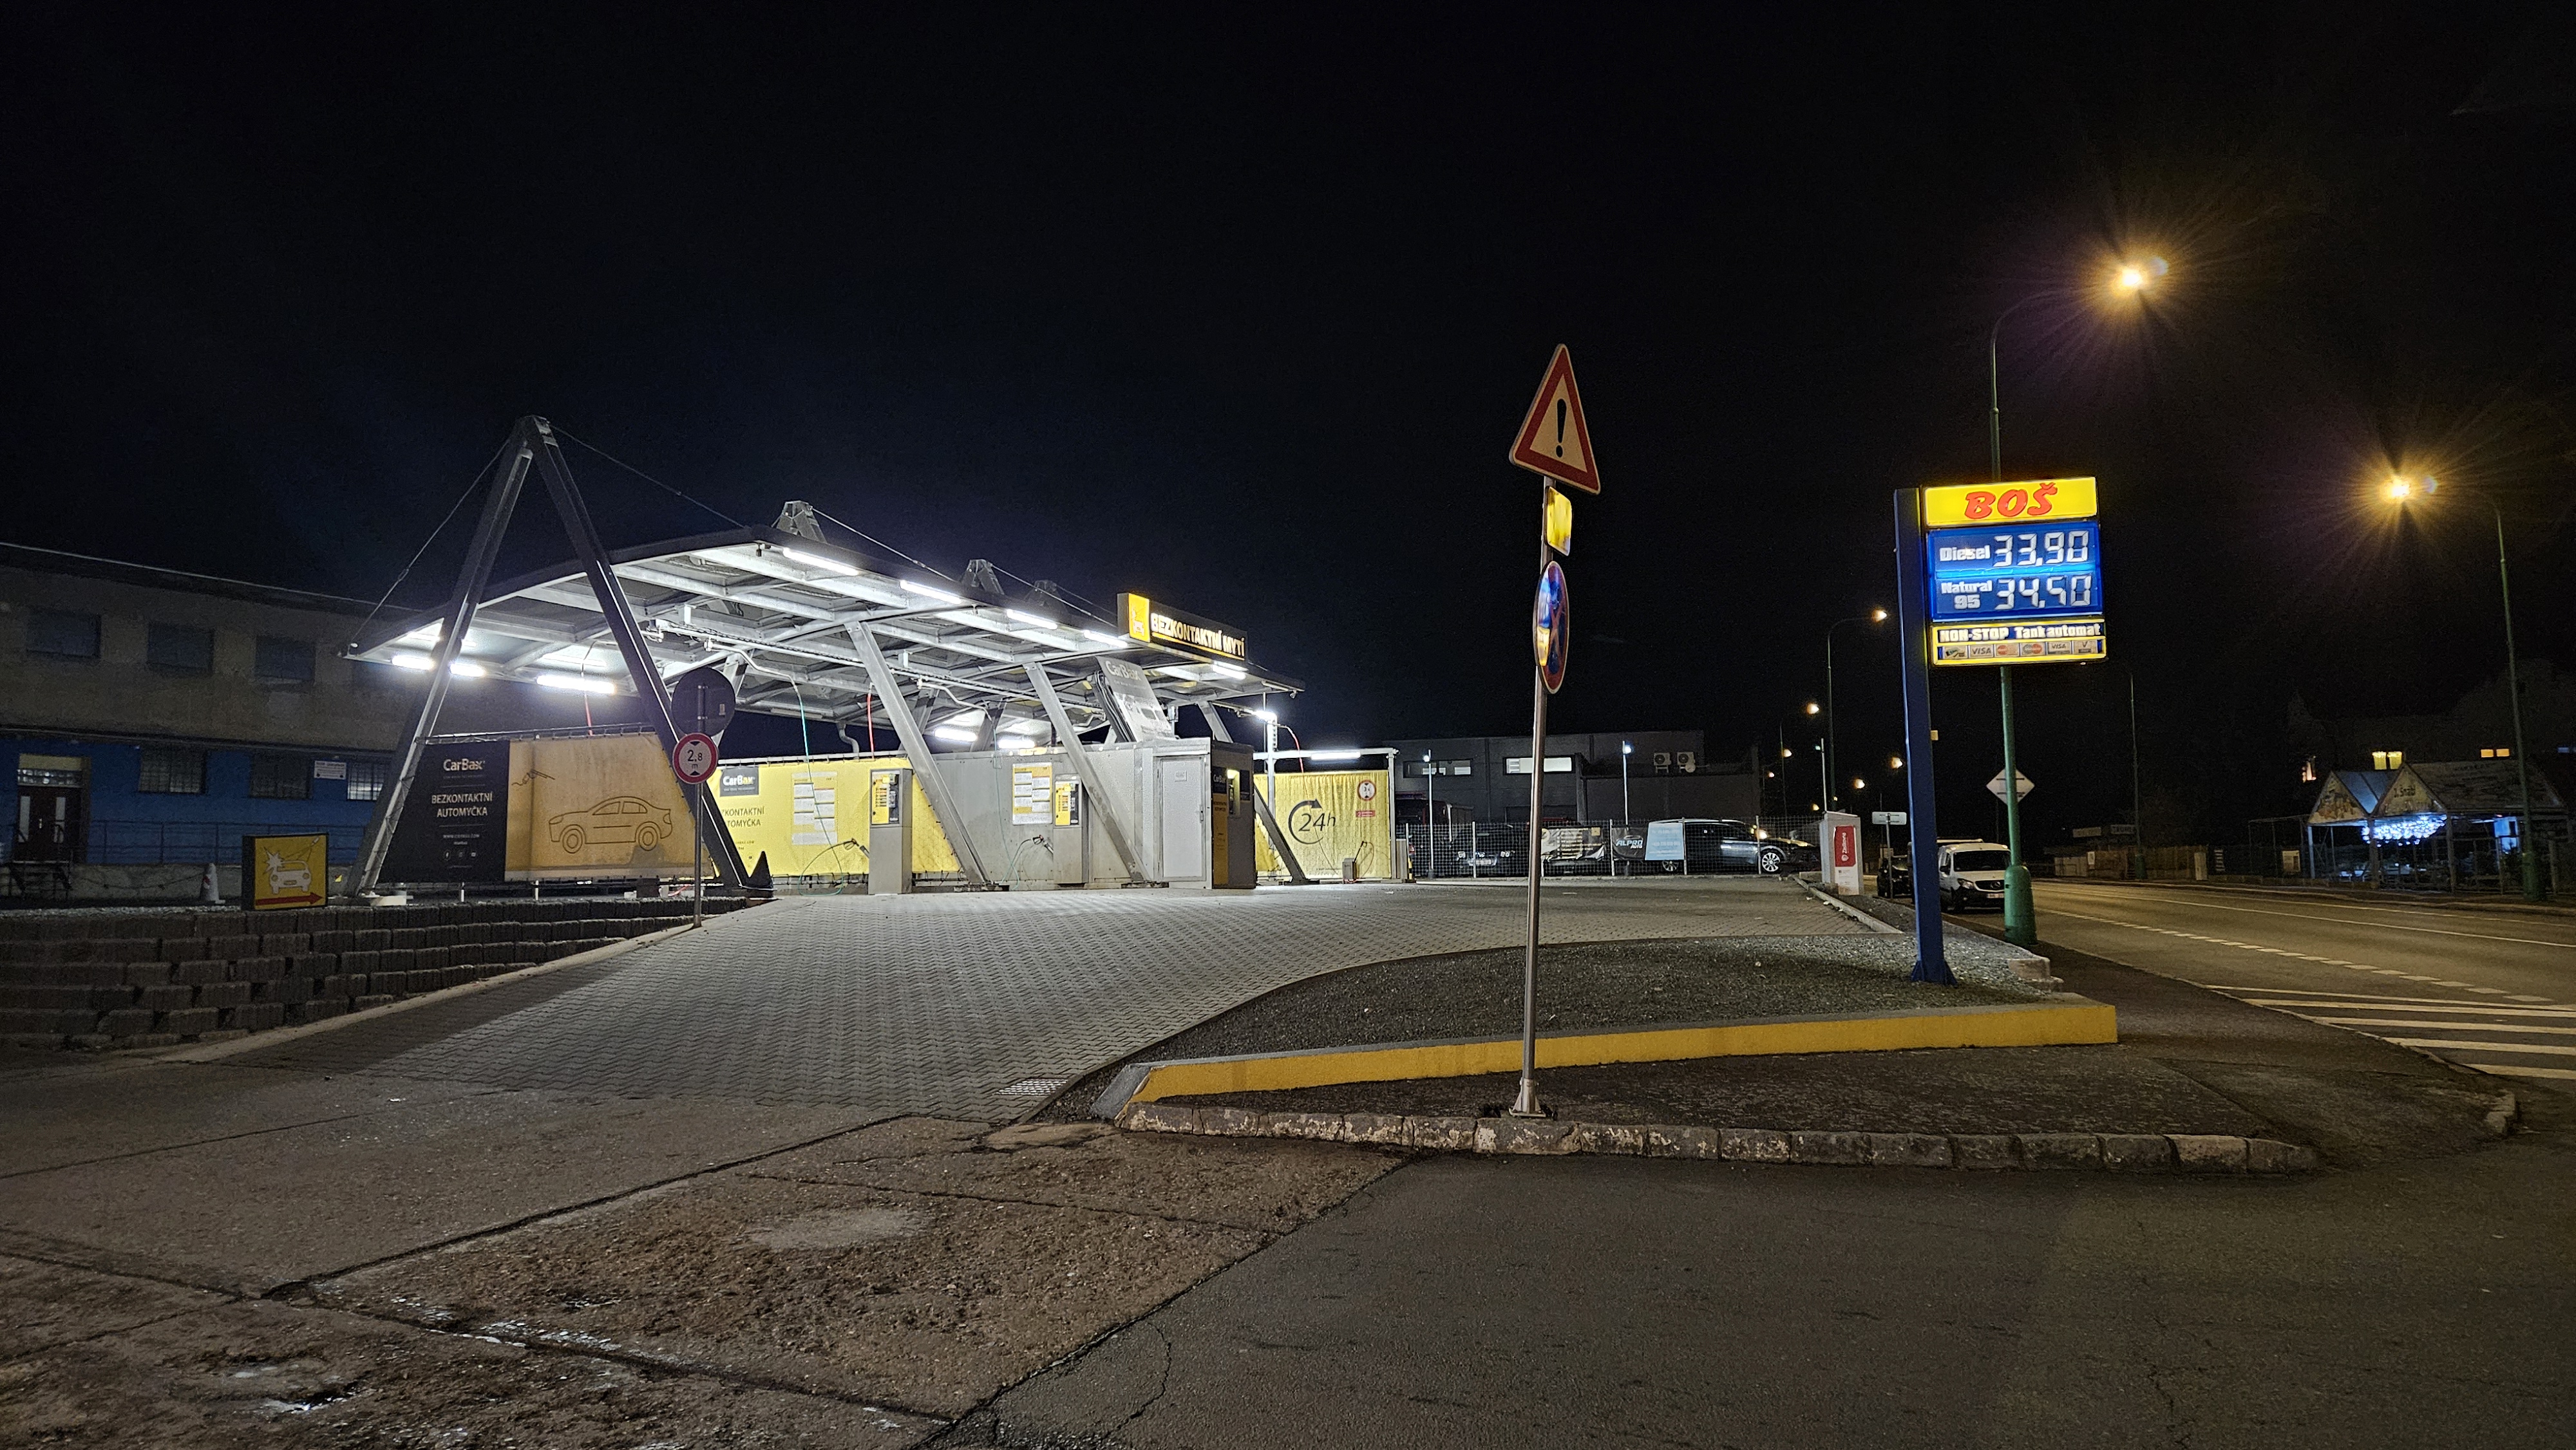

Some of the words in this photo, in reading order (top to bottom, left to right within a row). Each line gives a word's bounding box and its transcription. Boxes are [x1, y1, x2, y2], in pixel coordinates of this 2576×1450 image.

[1964, 482, 2058, 520] BOŠ
[1939, 545, 1991, 562] Diesel
[1993, 530, 2089, 567] 33,90
[1941, 579, 1993, 594] Natural
[1953, 594, 1981, 610] 95
[1150, 612, 1222, 651] BEZKONTAKTNÍ
[1939, 627, 2010, 643] NON-STOP
[1972, 647, 1992, 655] VISA
[442, 758, 484, 771] CarBax
[722, 775, 754, 787] CarBax
[431, 791, 493, 804] BEZKONTAKTNÍ
[437, 805, 488, 818] AUTOMYČKA
[1298, 813, 1336, 831] 24h
